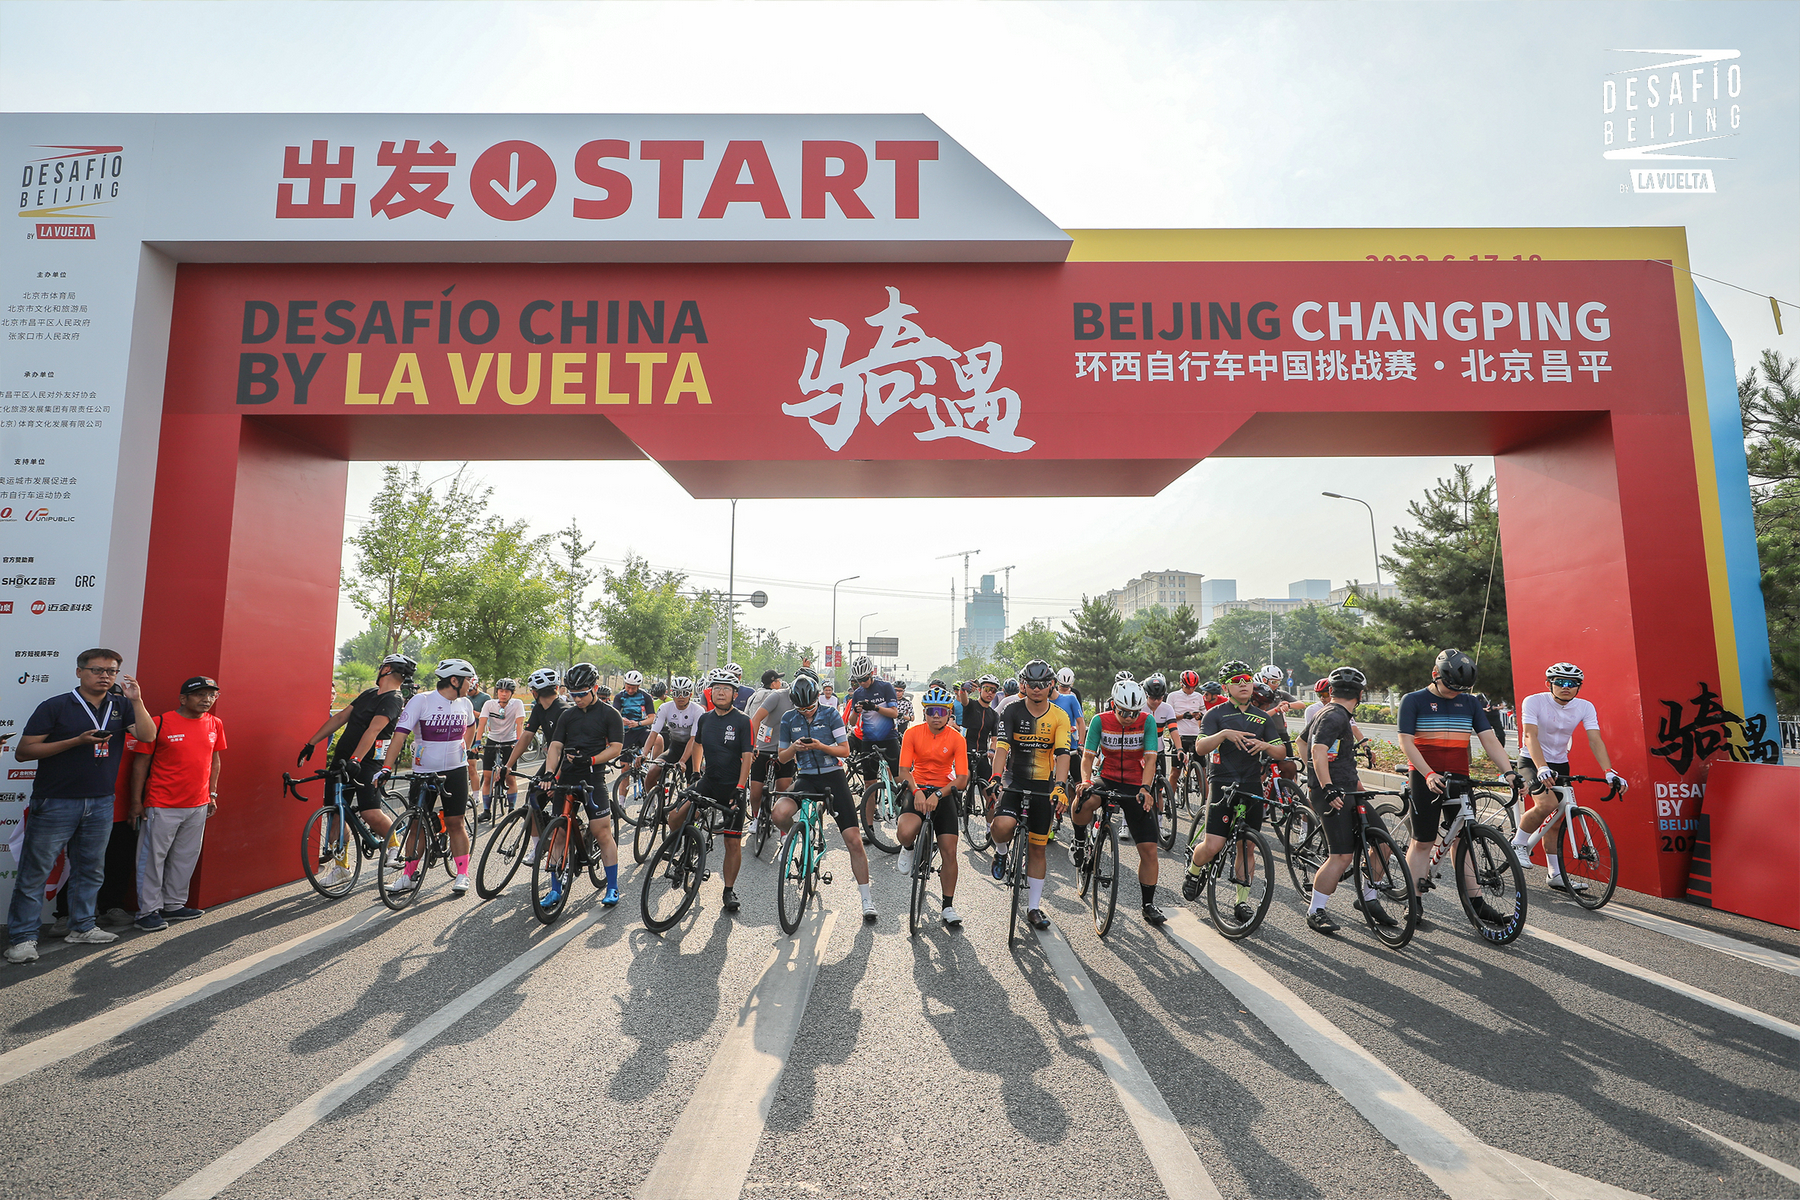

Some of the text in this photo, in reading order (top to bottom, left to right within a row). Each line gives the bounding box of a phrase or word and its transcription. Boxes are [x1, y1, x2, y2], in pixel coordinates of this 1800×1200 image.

[21, 154, 123, 188] DESAFÍO
[275, 139, 457, 220] 出发
[573, 139, 939, 220] START
[20, 181, 119, 208] BEIJING
[54, 226, 91, 237] VUELTA
[23, 292, 76, 300] 北京市体育局
[8, 305, 88, 313] 北京市文化和旅游局
[241, 284, 709, 345] DESAFÍO CHINA
[1, 319, 91, 327] 北京市昌平区人民政府
[1073, 301, 1611, 342] BEIJING CHANGPING
[8, 332, 80, 340] 张家口市人民政府
[781, 286, 1036, 453] 骑遇
[235, 352, 713, 405] BY LA VUELTA
[0, 405, 111, 413] 化旅游发展集团有限责任公司
[1, 577, 38, 585] SHOKZ
[75, 575, 96, 588] GRC
[31, 674, 49, 683] 抖音
[1658, 799, 1684, 817] BY
